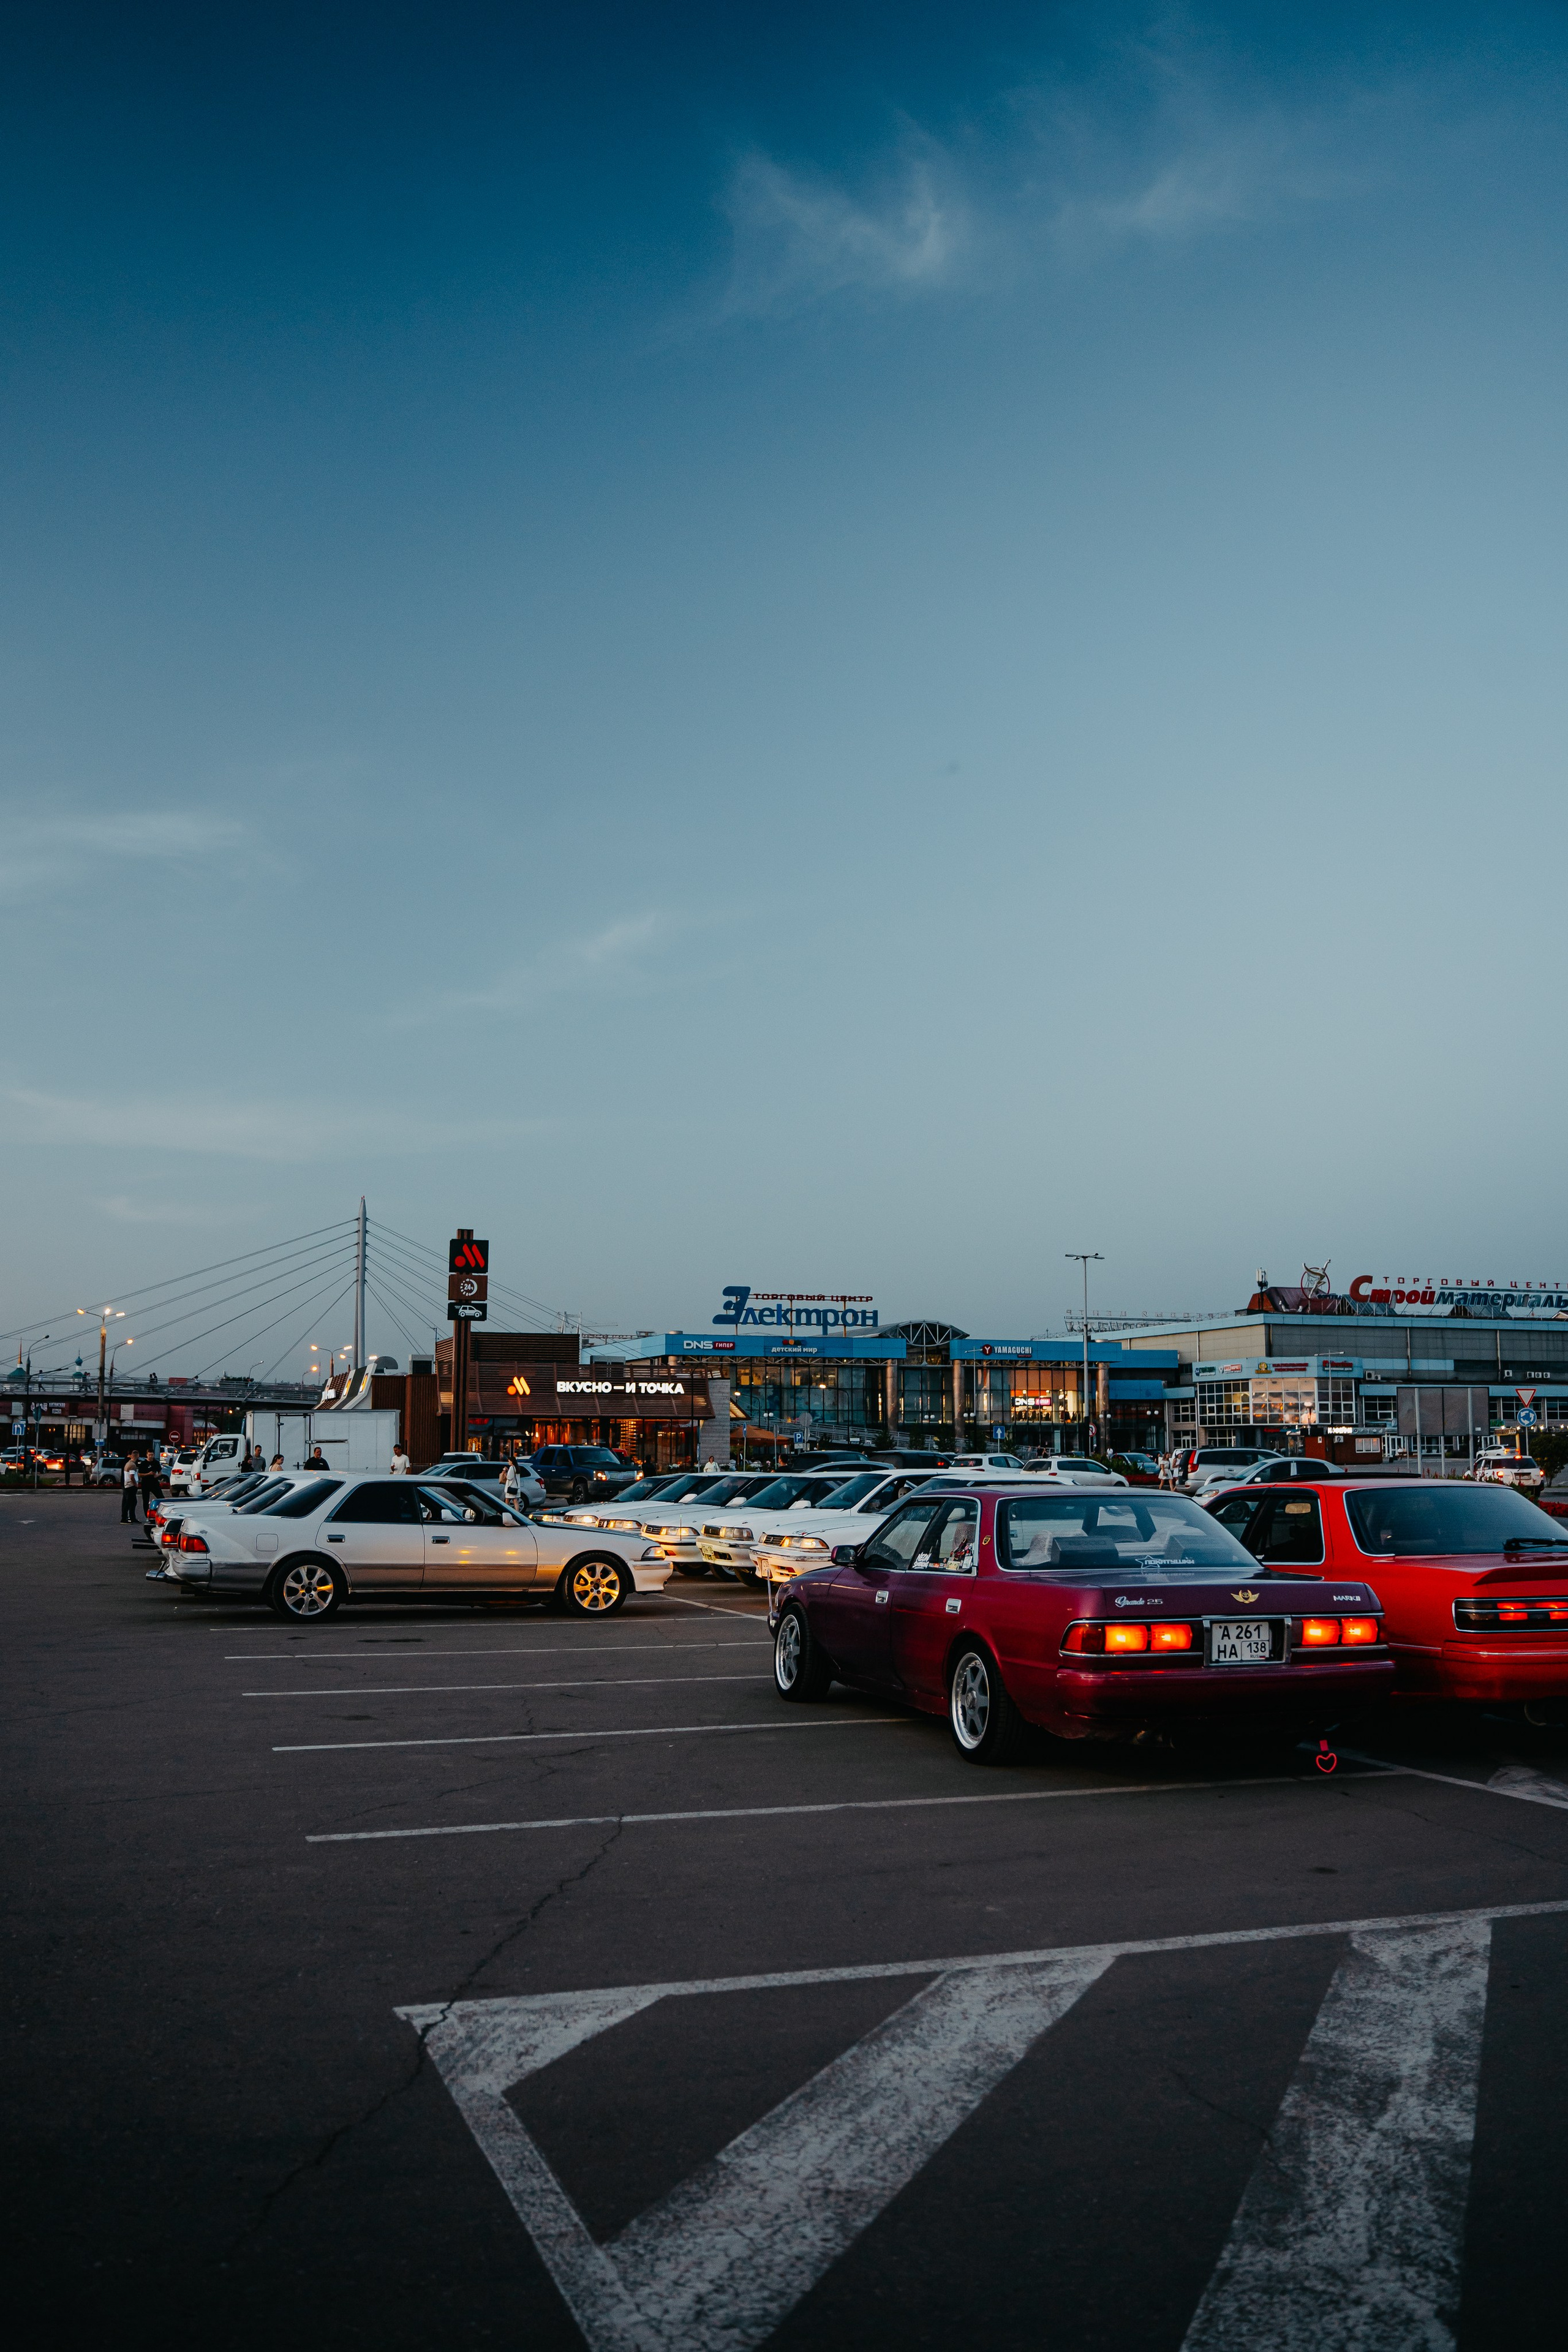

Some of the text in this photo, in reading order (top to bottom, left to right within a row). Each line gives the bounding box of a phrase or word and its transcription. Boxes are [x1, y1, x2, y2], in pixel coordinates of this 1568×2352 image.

[1383, 1276, 1568, 1289] ТОРГОВЫЙ ЦЕНТ
[712, 1286, 878, 1335] Электрон
[683, 1340, 713, 1349] DNS
[556, 1381, 612, 1393] ВКУСНО
[625, 1382, 636, 1393] И
[638, 1382, 685, 1394] ТОЧКА
[1115, 1596, 1145, 1608] Grande
[1235, 1624, 1261, 1639] 261
[1246, 1642, 1266, 1653] 138
